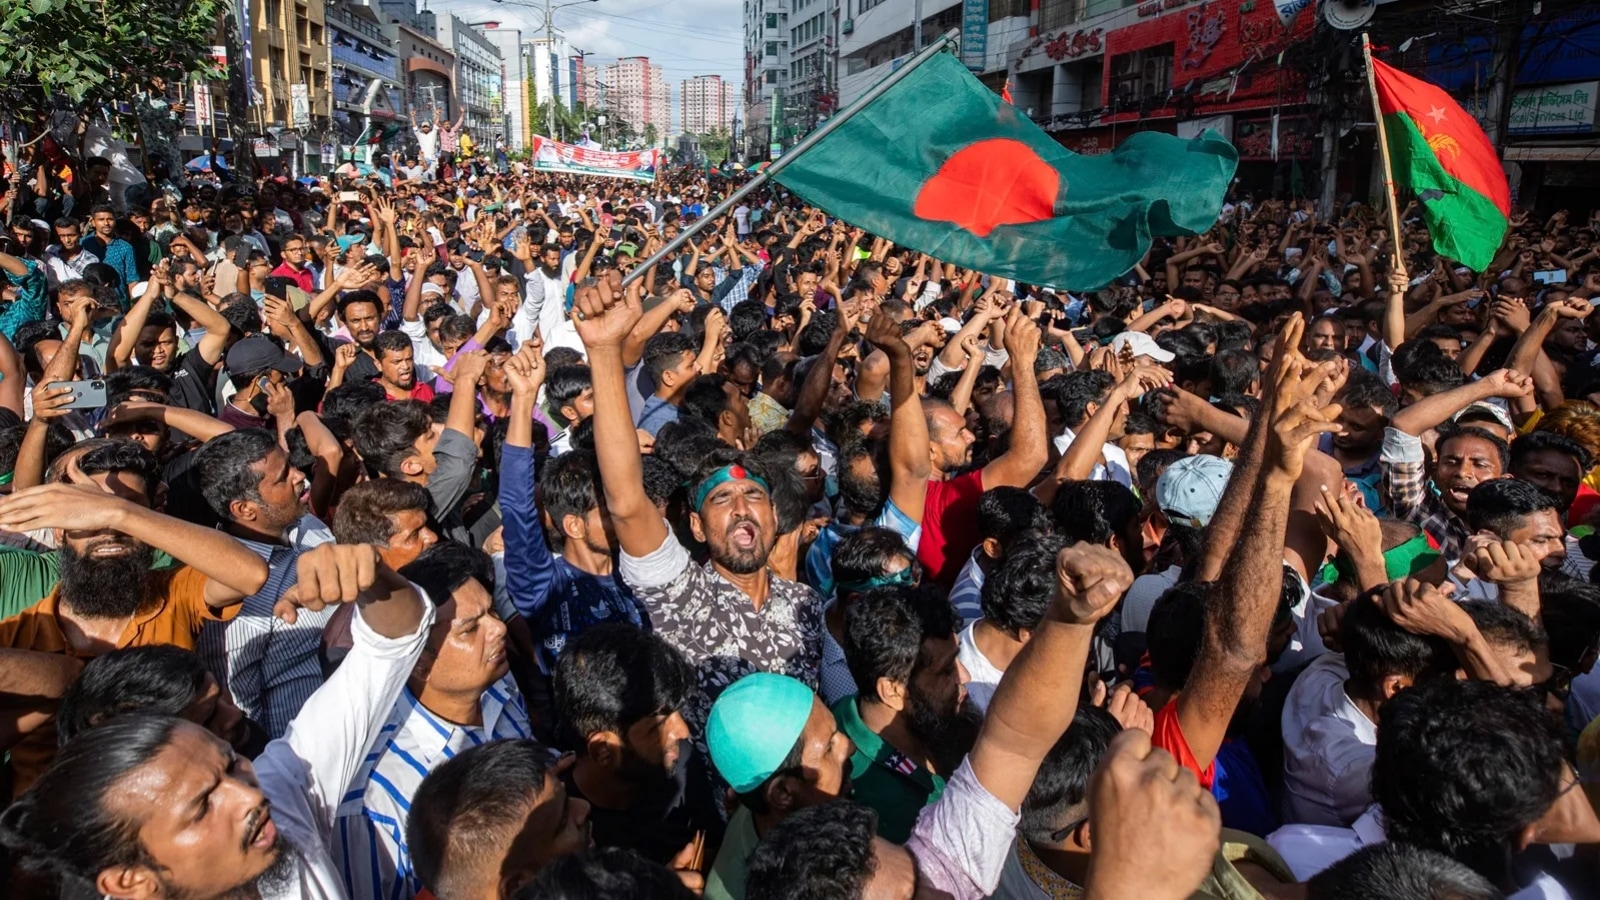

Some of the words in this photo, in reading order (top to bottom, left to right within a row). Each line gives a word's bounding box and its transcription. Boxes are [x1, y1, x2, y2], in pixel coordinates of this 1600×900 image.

[1530, 111, 1566, 123] Services
[1569, 108, 1586, 120] Ltd.
[1081, 137, 1099, 147] CAR
